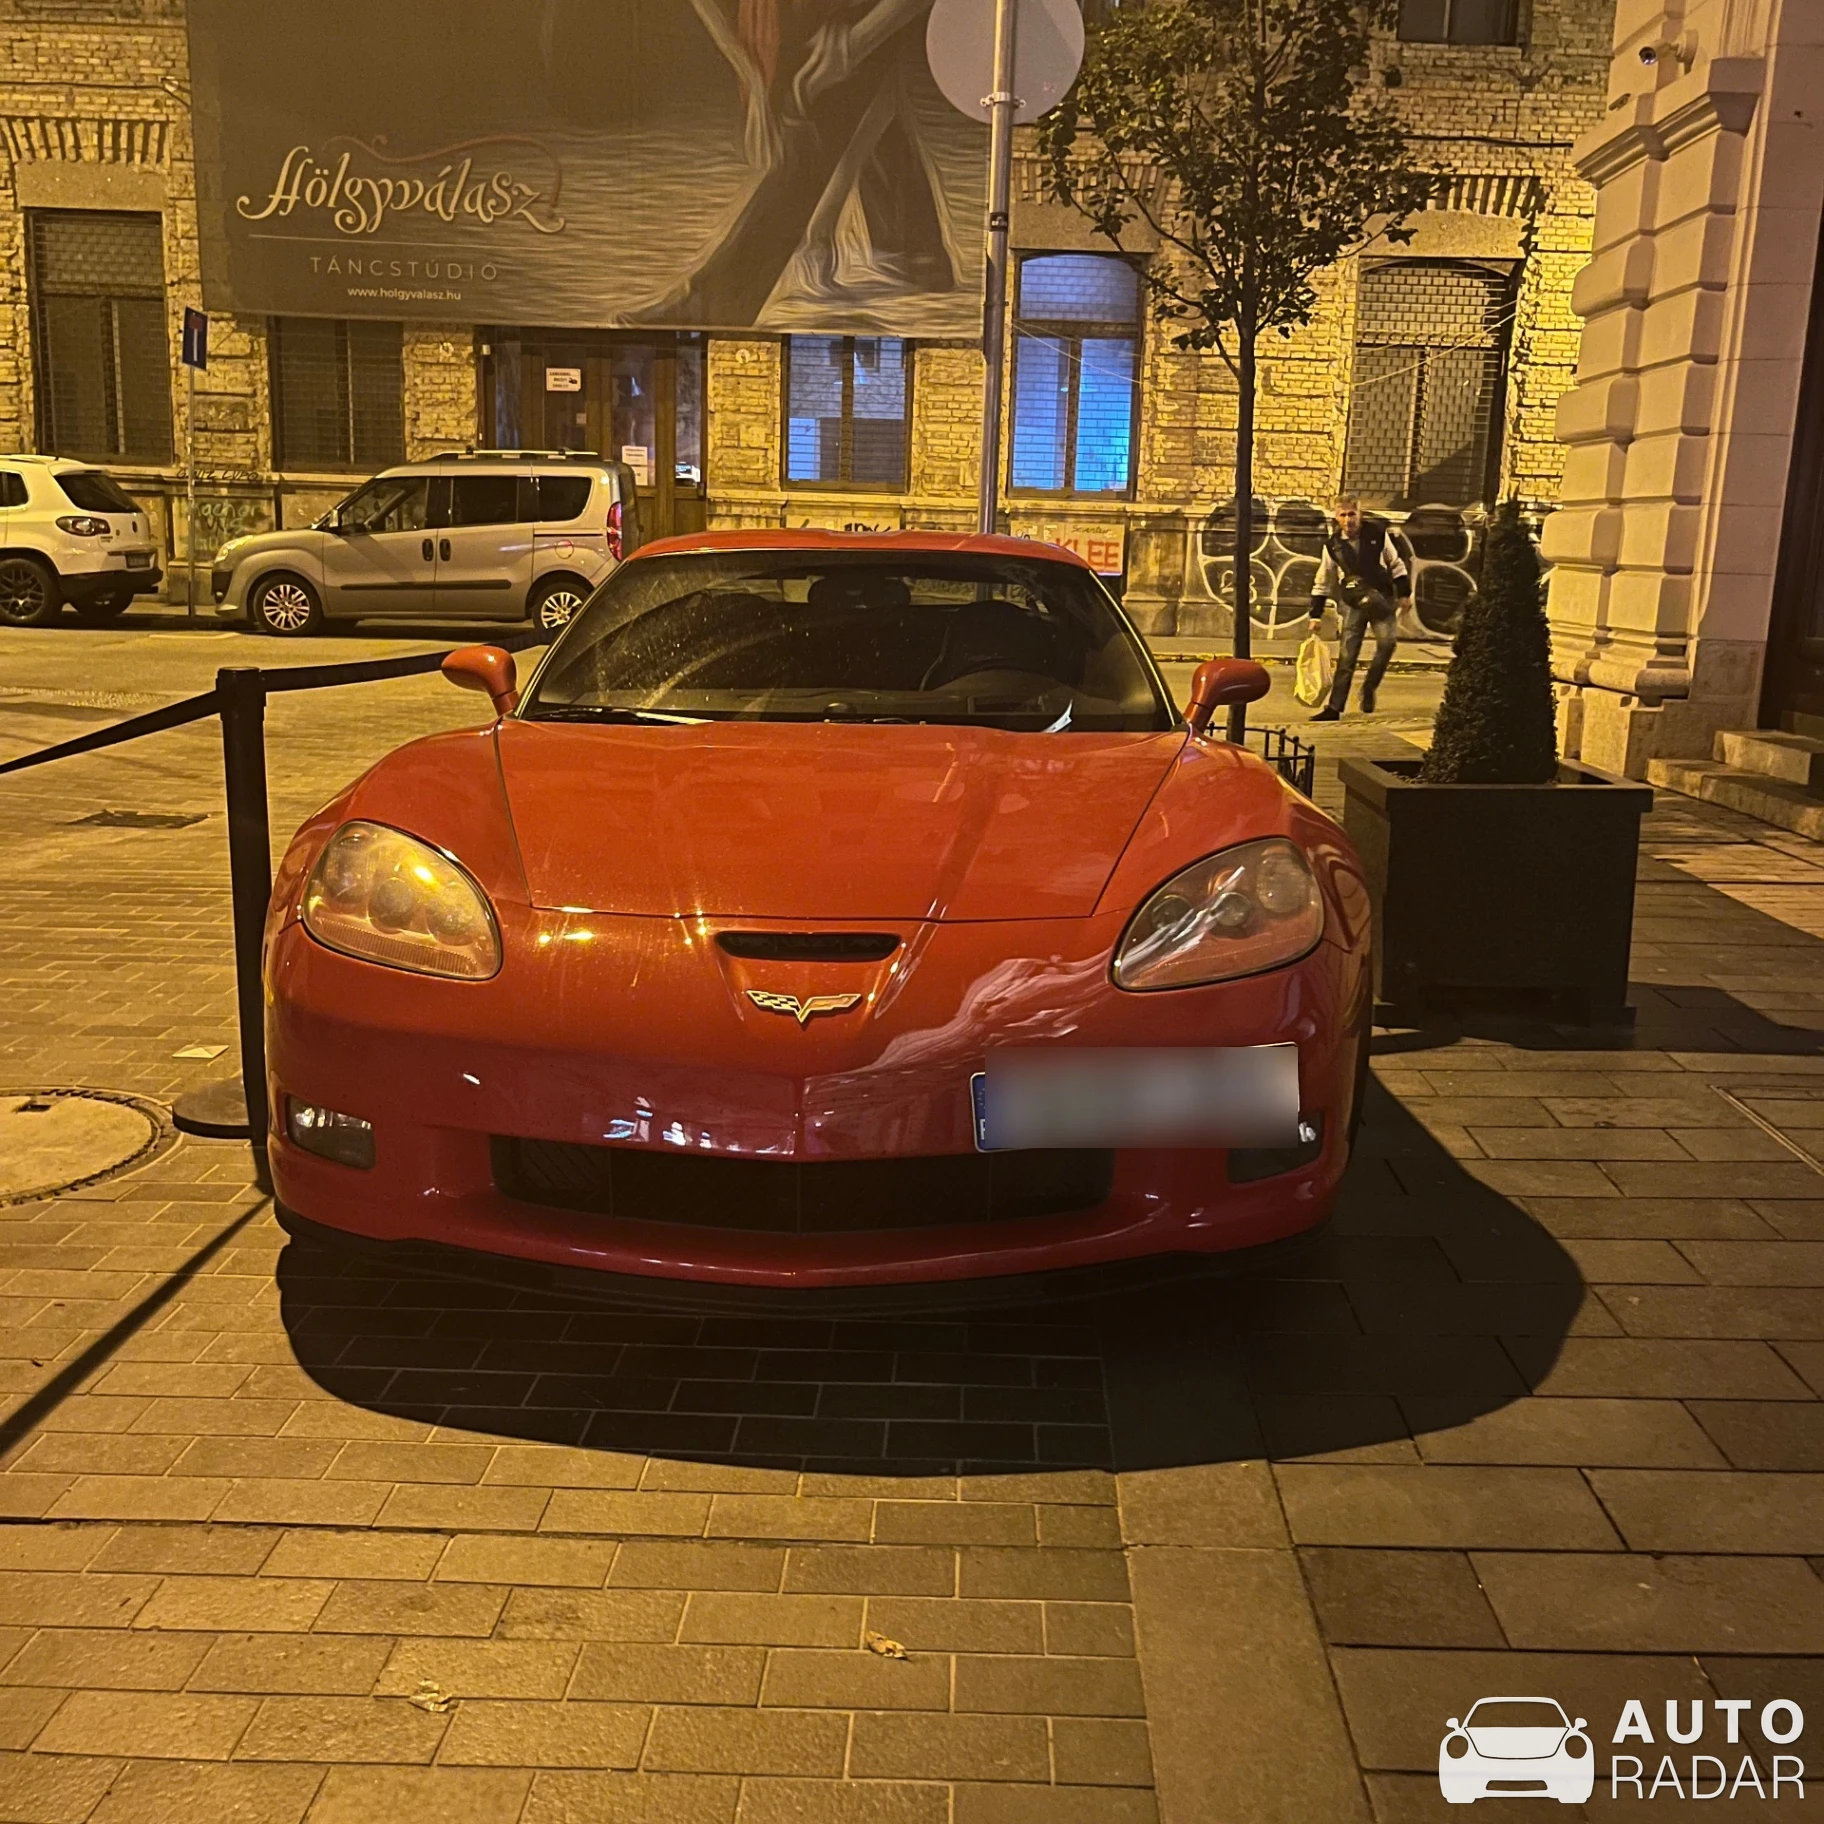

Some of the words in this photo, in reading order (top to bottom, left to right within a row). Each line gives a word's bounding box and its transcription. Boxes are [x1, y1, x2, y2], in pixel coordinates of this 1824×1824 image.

[236, 146, 565, 234] Hölgyválasz
[310, 254, 499, 281] TÁNCSTÚDIÓ
[347, 285, 462, 303] www.holgyvalasz.hu
